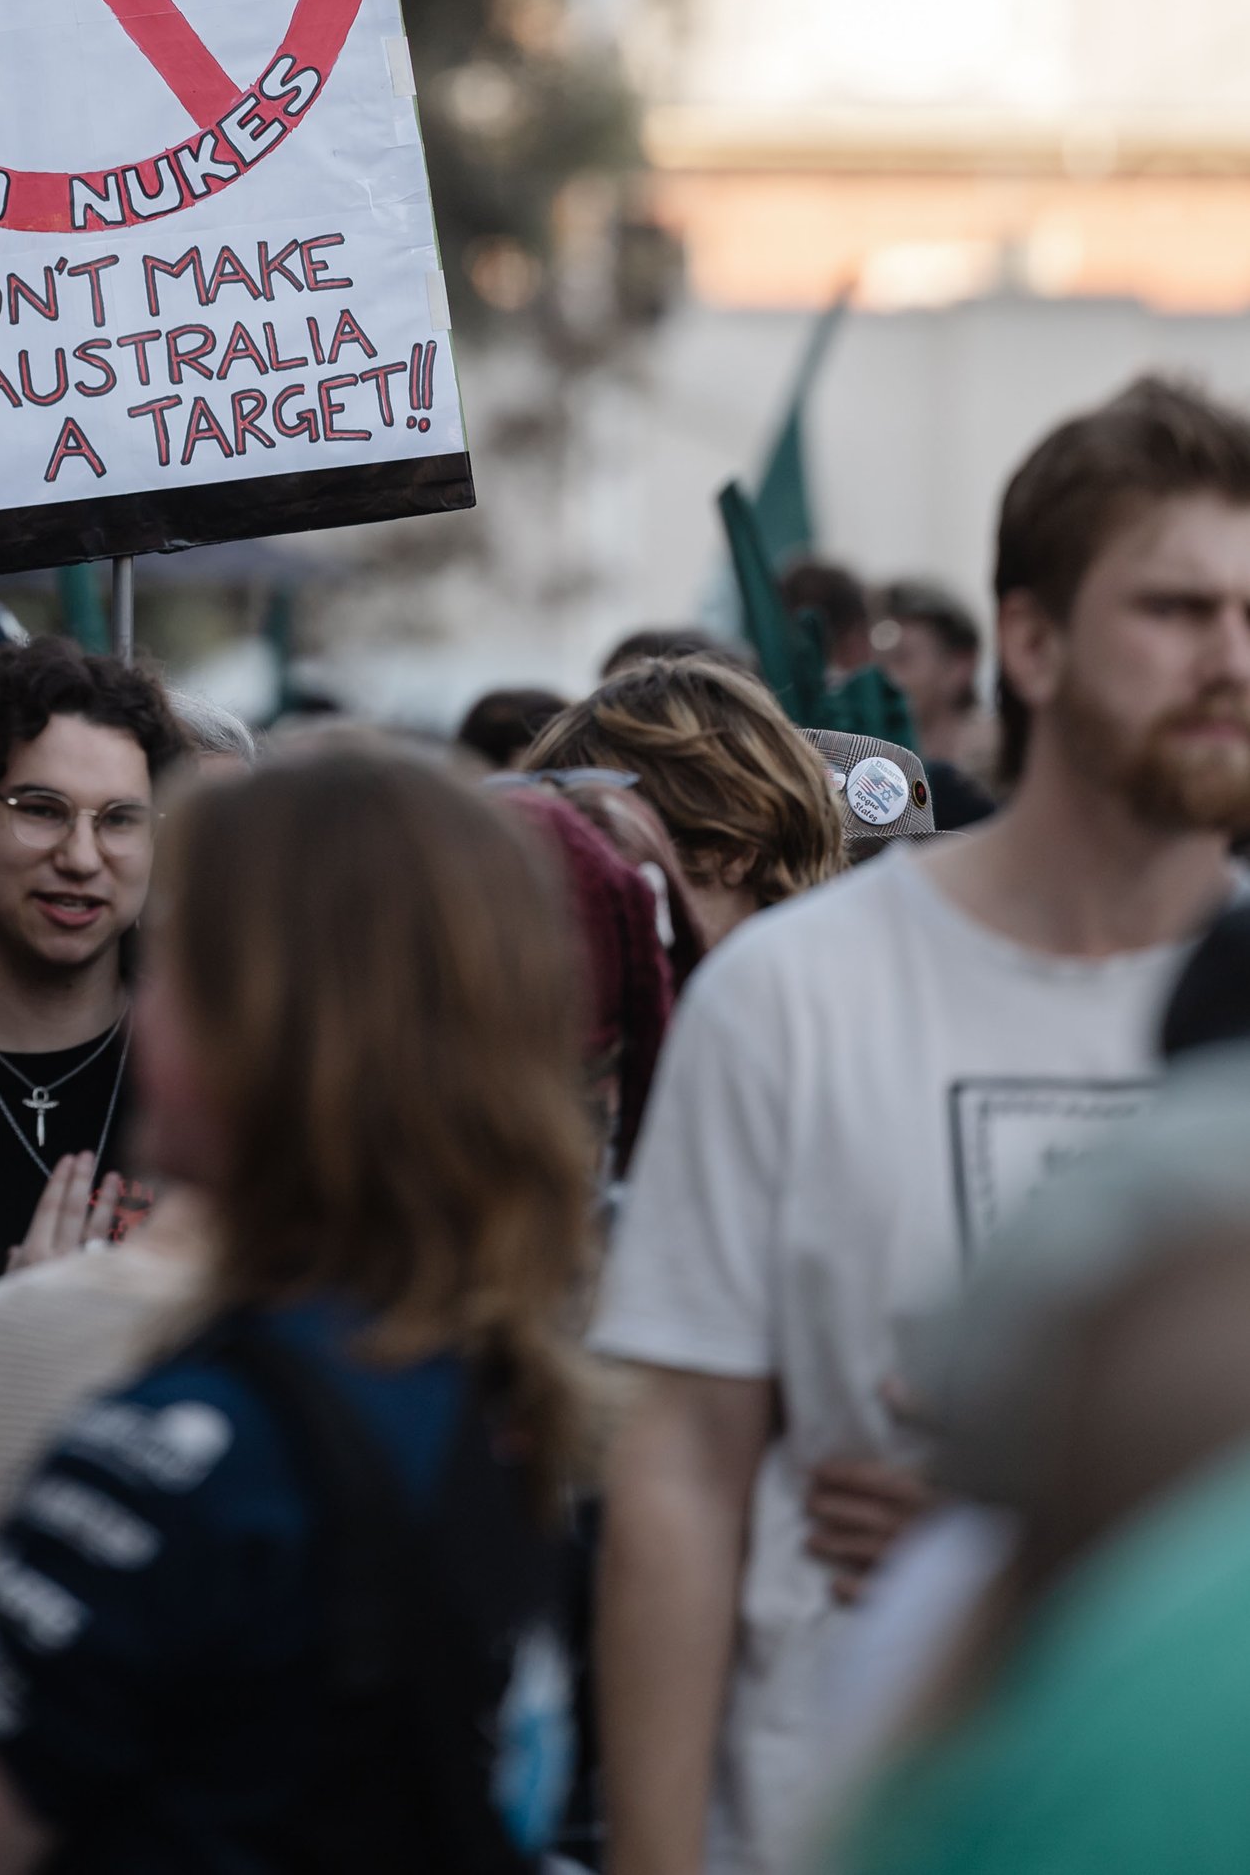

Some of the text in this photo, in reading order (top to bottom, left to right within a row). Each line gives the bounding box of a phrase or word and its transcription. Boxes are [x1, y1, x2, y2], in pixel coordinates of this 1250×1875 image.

[69, 53, 322, 231] NUKES
[142, 232, 354, 317] MAKE
[45, 417, 107, 482] A
[854, 802, 878, 822] States
[855, 791, 880, 810] Rogue
